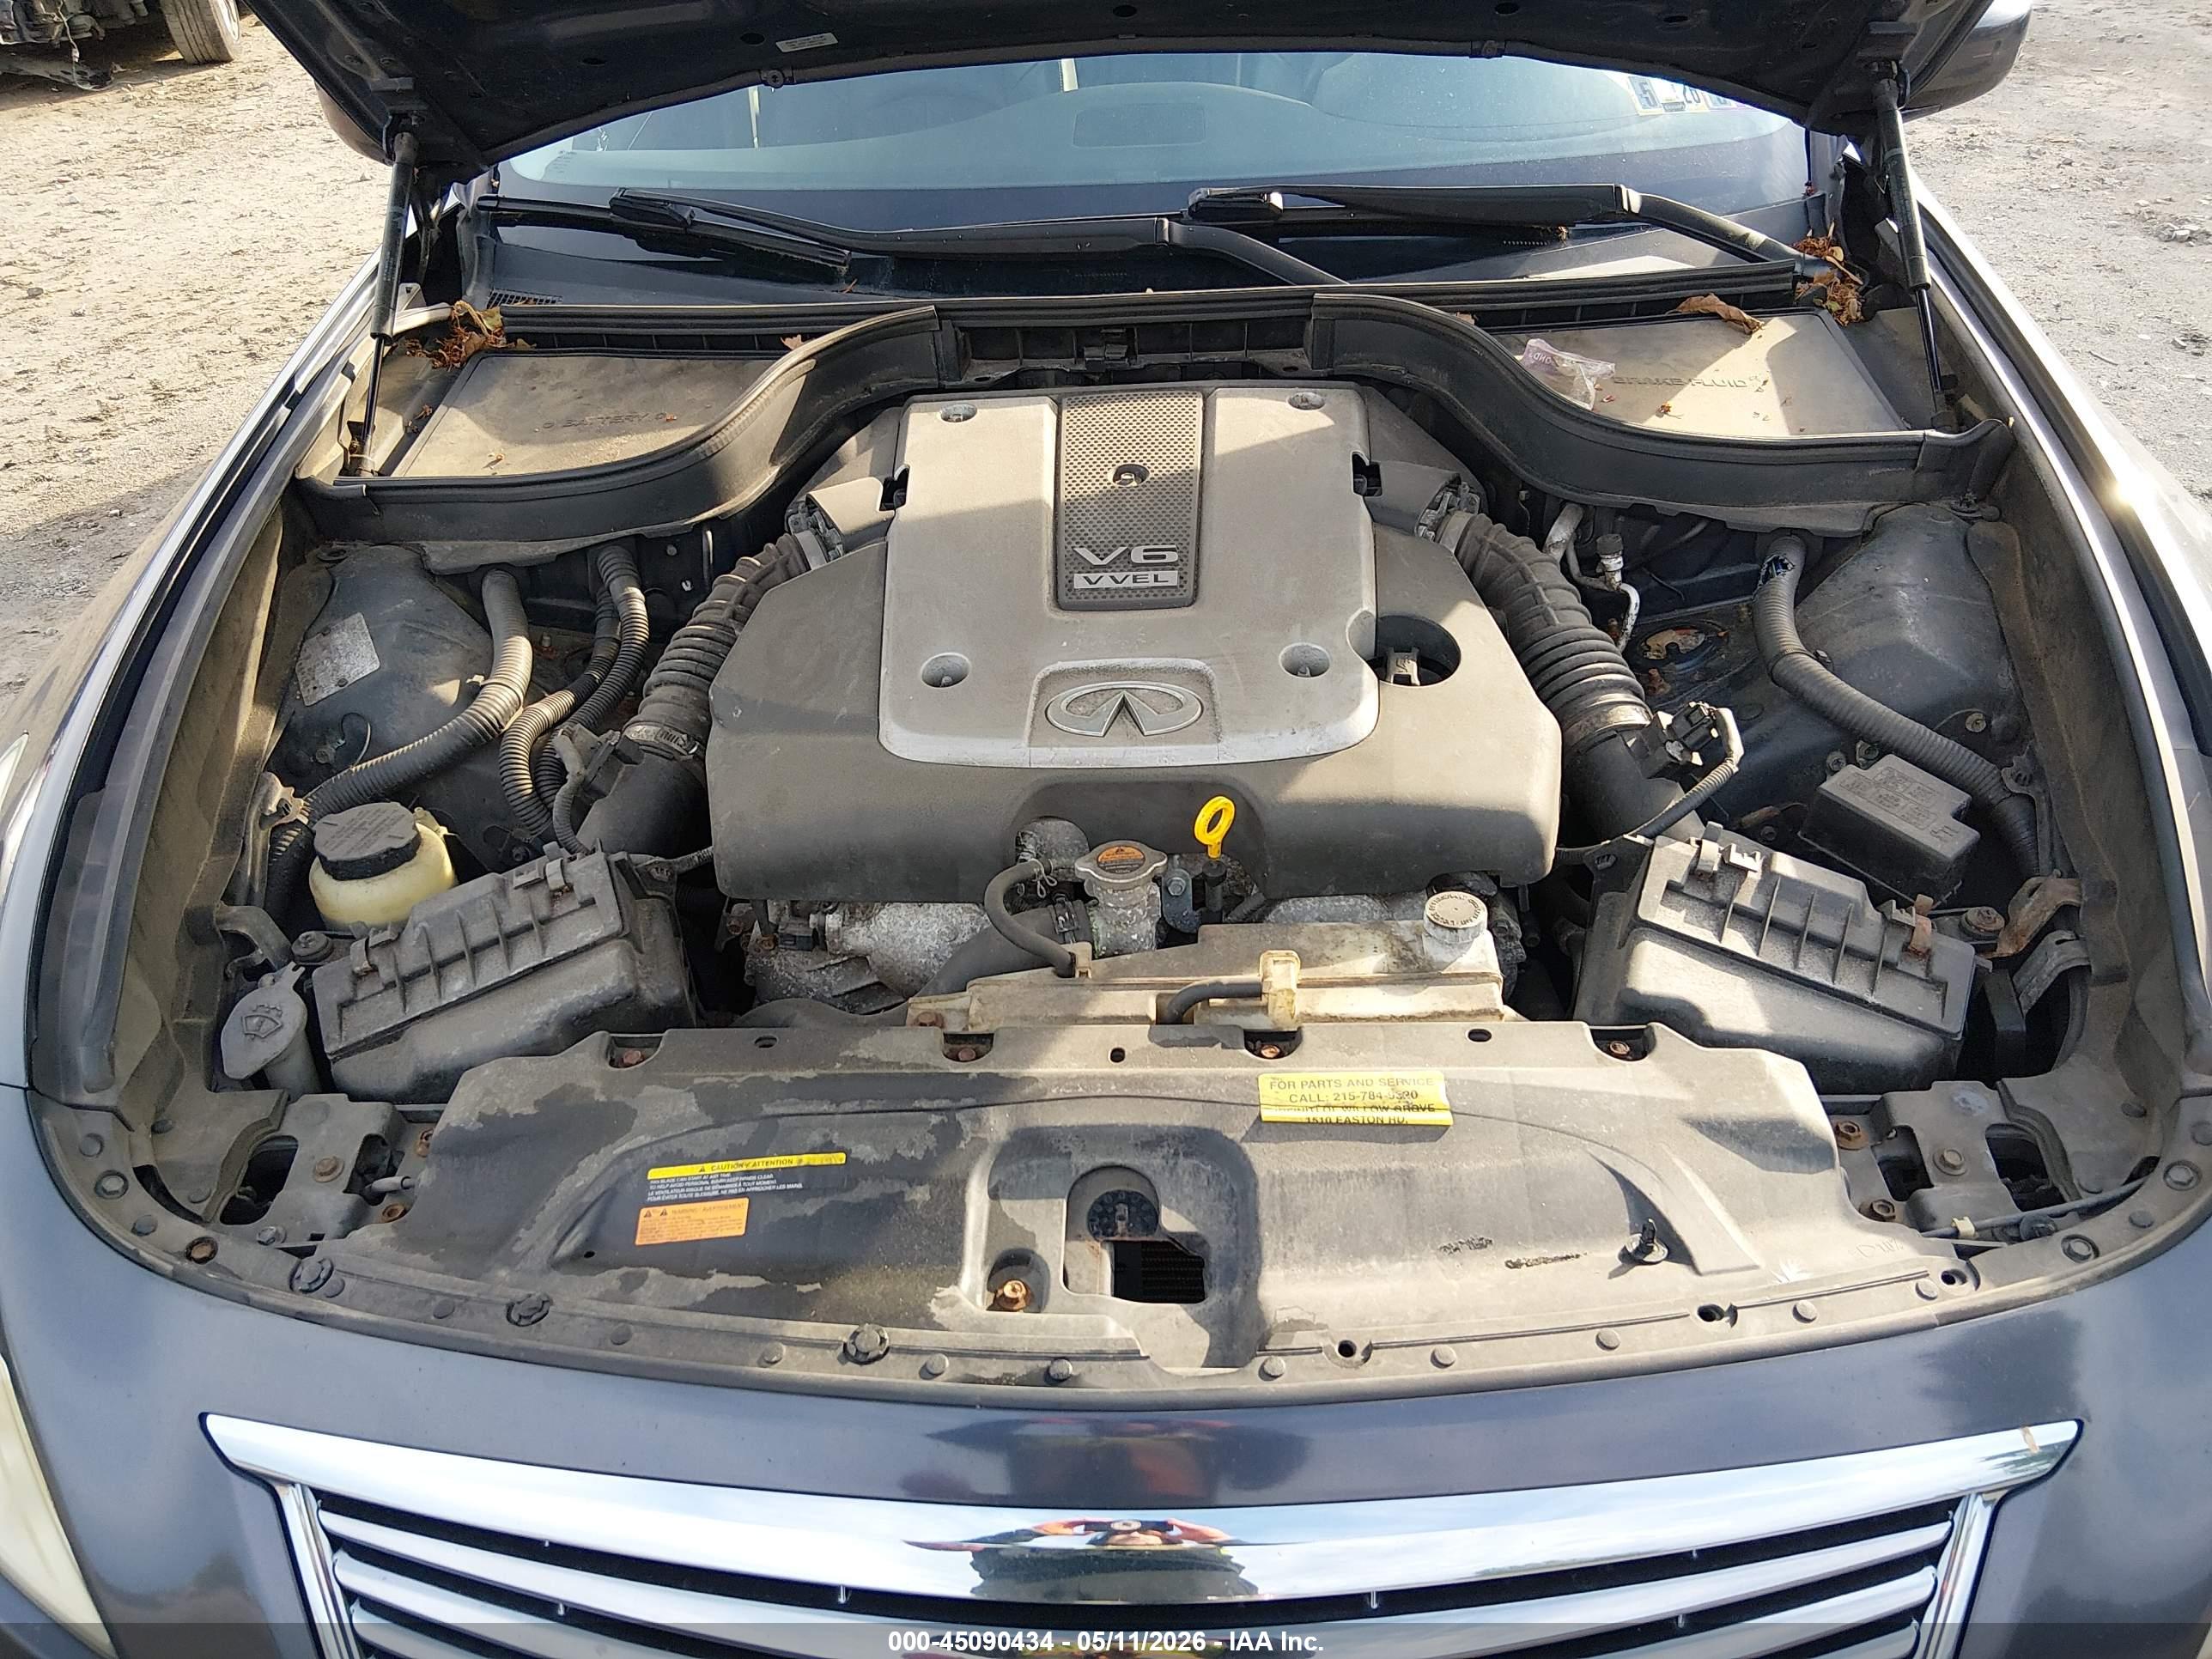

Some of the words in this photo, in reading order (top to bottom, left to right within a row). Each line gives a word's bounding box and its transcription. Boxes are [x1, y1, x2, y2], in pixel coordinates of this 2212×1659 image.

[1613, 376, 1685, 386] BRAKE
[1688, 378, 1748, 388] FLUID
[562, 412, 650, 427] BATTERY
[1073, 544, 1179, 567] V6
[1083, 574, 1170, 586] VVEL
[1269, 1080, 1296, 1091] FOR
[1301, 1079, 1342, 1090] PARTS
[1346, 1079, 1374, 1087] AND
[1378, 1078, 1436, 1087] SERVICE
[1289, 1093, 1328, 1103] CALL:
[1335, 1115, 1384, 1125] EASTON
[711, 1163, 744, 1172] CAUTION
[751, 1158, 793, 1169] ATTENTION
